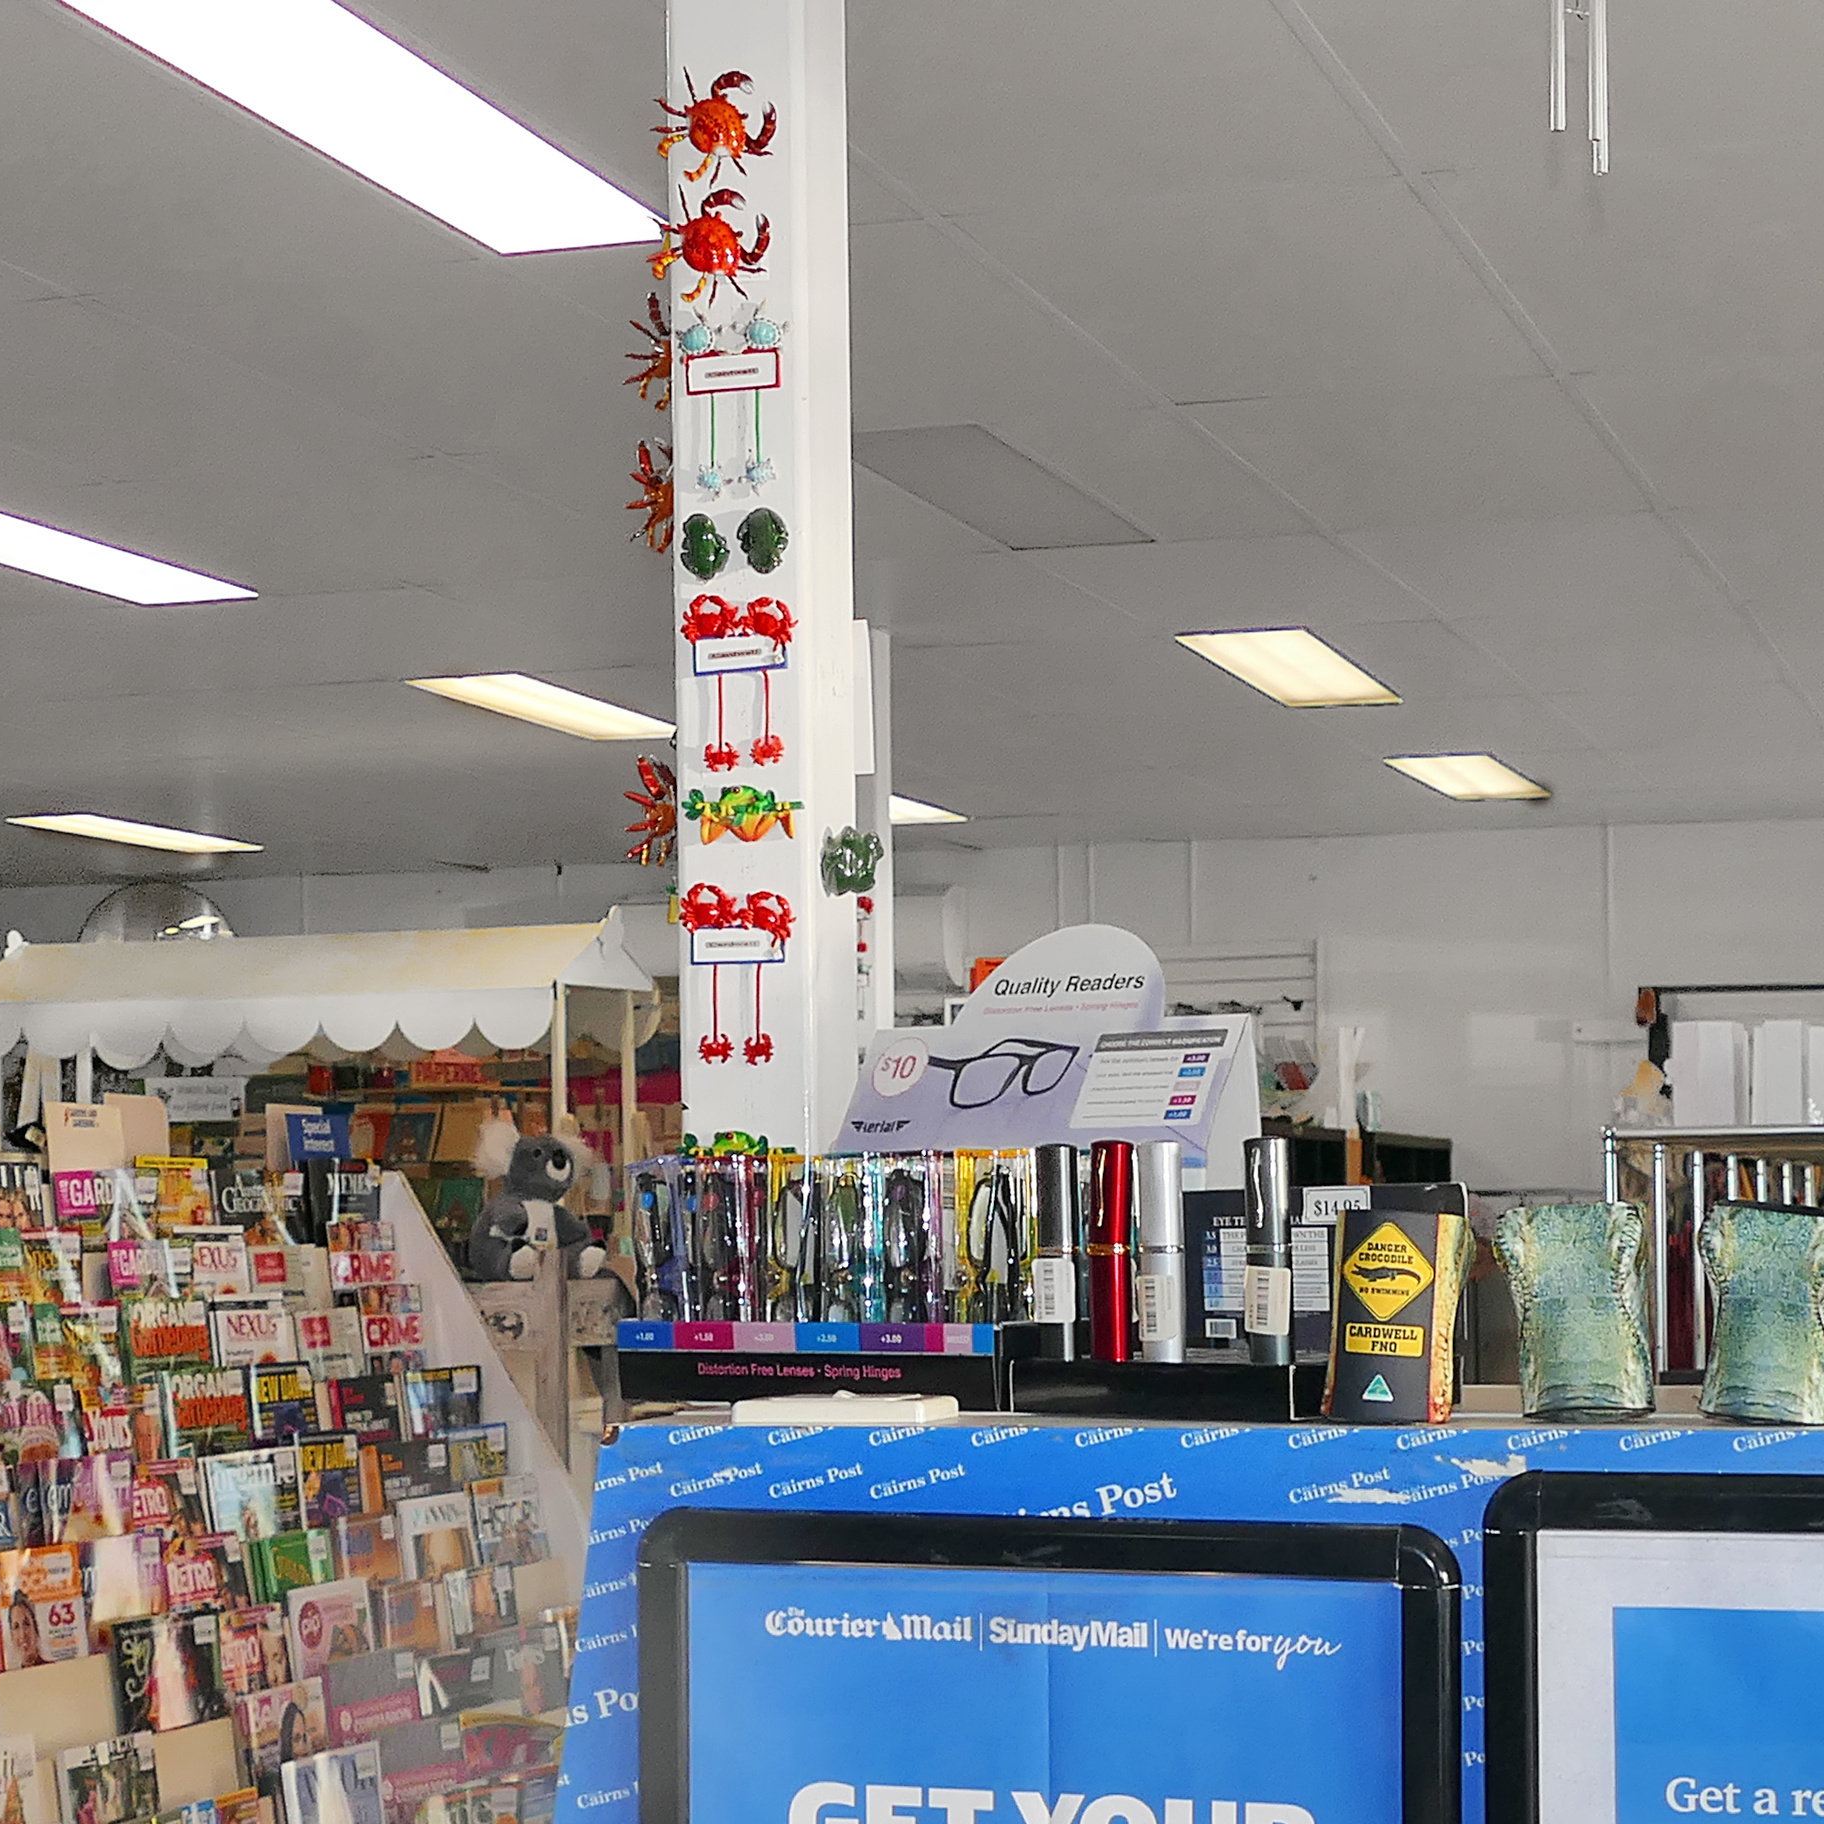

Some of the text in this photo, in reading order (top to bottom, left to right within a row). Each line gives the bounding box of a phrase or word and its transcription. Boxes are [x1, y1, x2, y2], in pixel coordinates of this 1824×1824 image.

[994, 972, 1146, 999] Quality Readers
[880, 1055, 917, 1080] $10
[1367, 1241, 1407, 1254] DANGER
[1358, 1252, 1414, 1265] CROCODILE
[1349, 1325, 1418, 1341] CARDWELL
[1371, 1340, 1398, 1353] FNQ
[697, 1361, 902, 1381] Distortion Free Lenses Spring Hinges
[764, 1608, 880, 1640] Courier
[901, 1613, 973, 1643] Mail
[1272, 1634, 1341, 1671] you
[1665, 1775, 1741, 1817] Get
[1753, 1784, 1780, 1818] a
